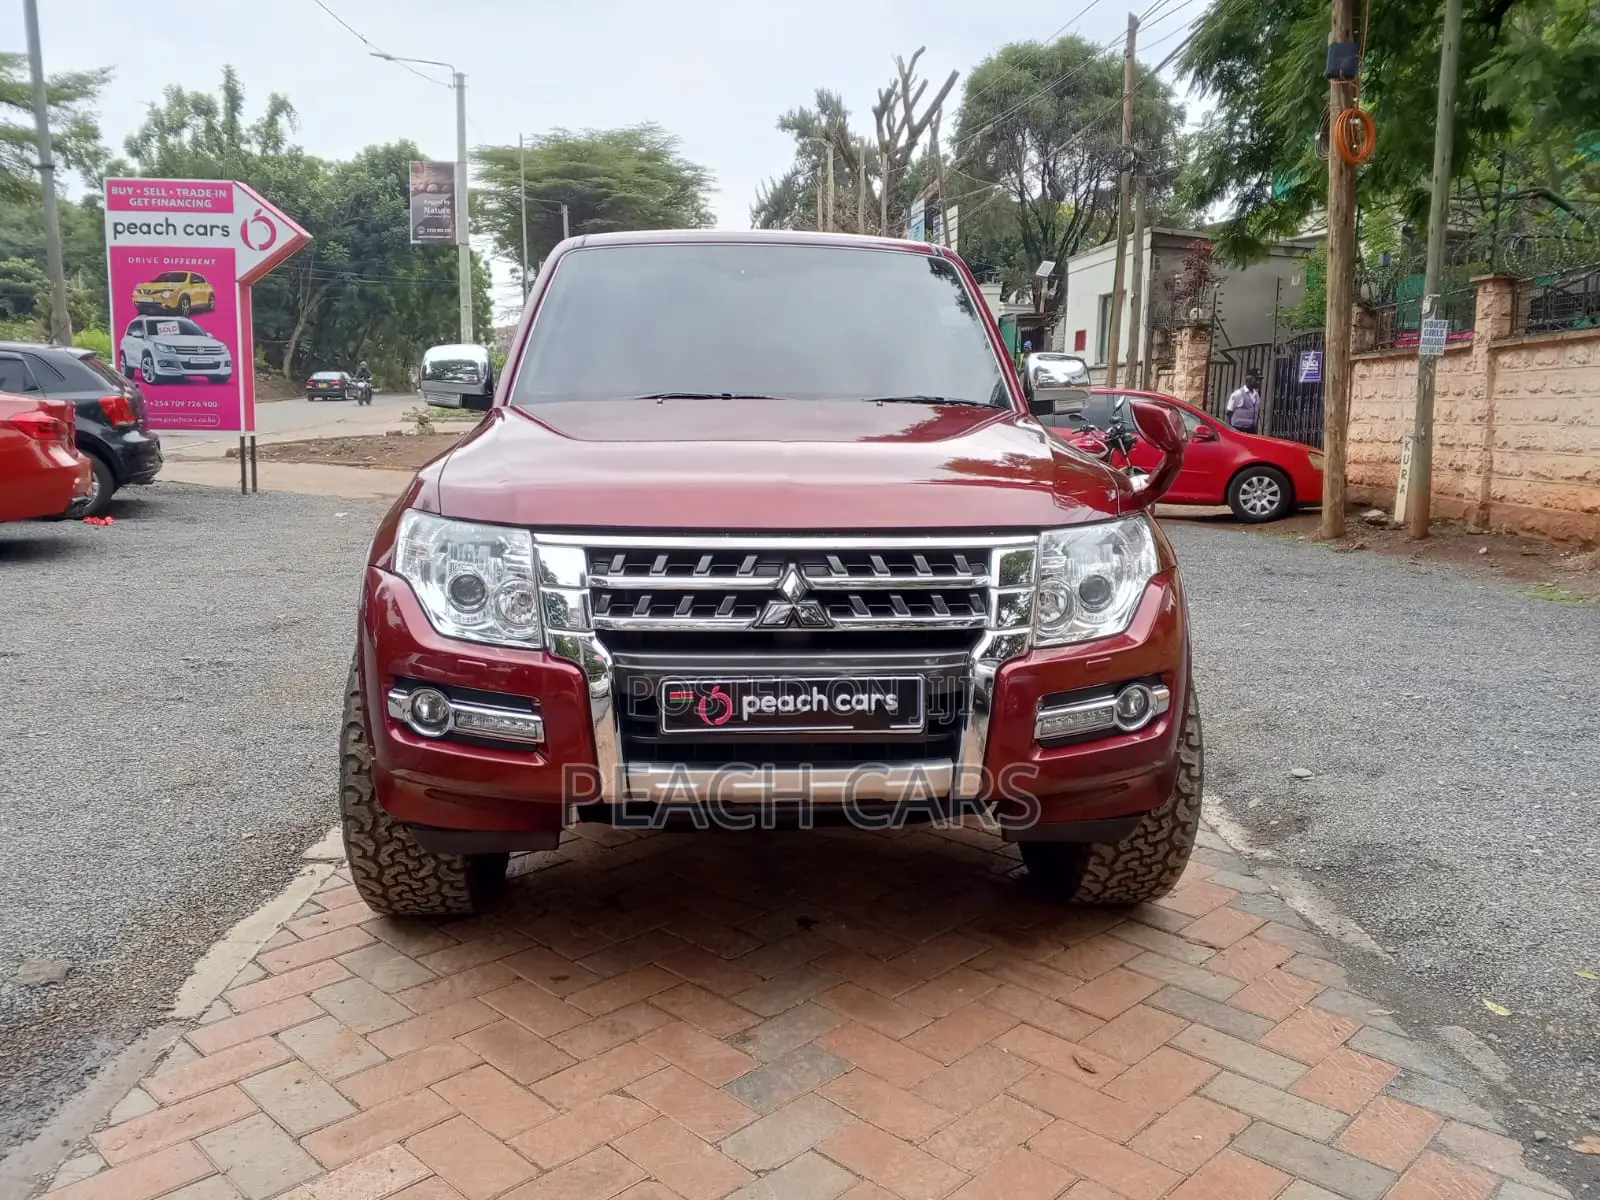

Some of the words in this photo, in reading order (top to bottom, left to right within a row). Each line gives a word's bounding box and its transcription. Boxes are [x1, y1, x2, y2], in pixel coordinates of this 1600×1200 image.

[111, 186, 133, 195] BUY
[143, 187, 167, 196] SELL
[175, 188, 227, 197] TRADE-IN
[129, 197, 150, 206] GET
[151, 198, 212, 208] FINANCING
[423, 206, 452, 214] Nature
[113, 216, 177, 240] peach
[183, 223, 231, 237] cars
[128, 256, 159, 264] DRIVE
[163, 257, 217, 265] DIFFERENT
[158, 325, 178, 334] SOLD
[1423, 329, 1445, 337] GIRLS
[742, 686, 829, 721] peach
[835, 692, 899, 712] cars
